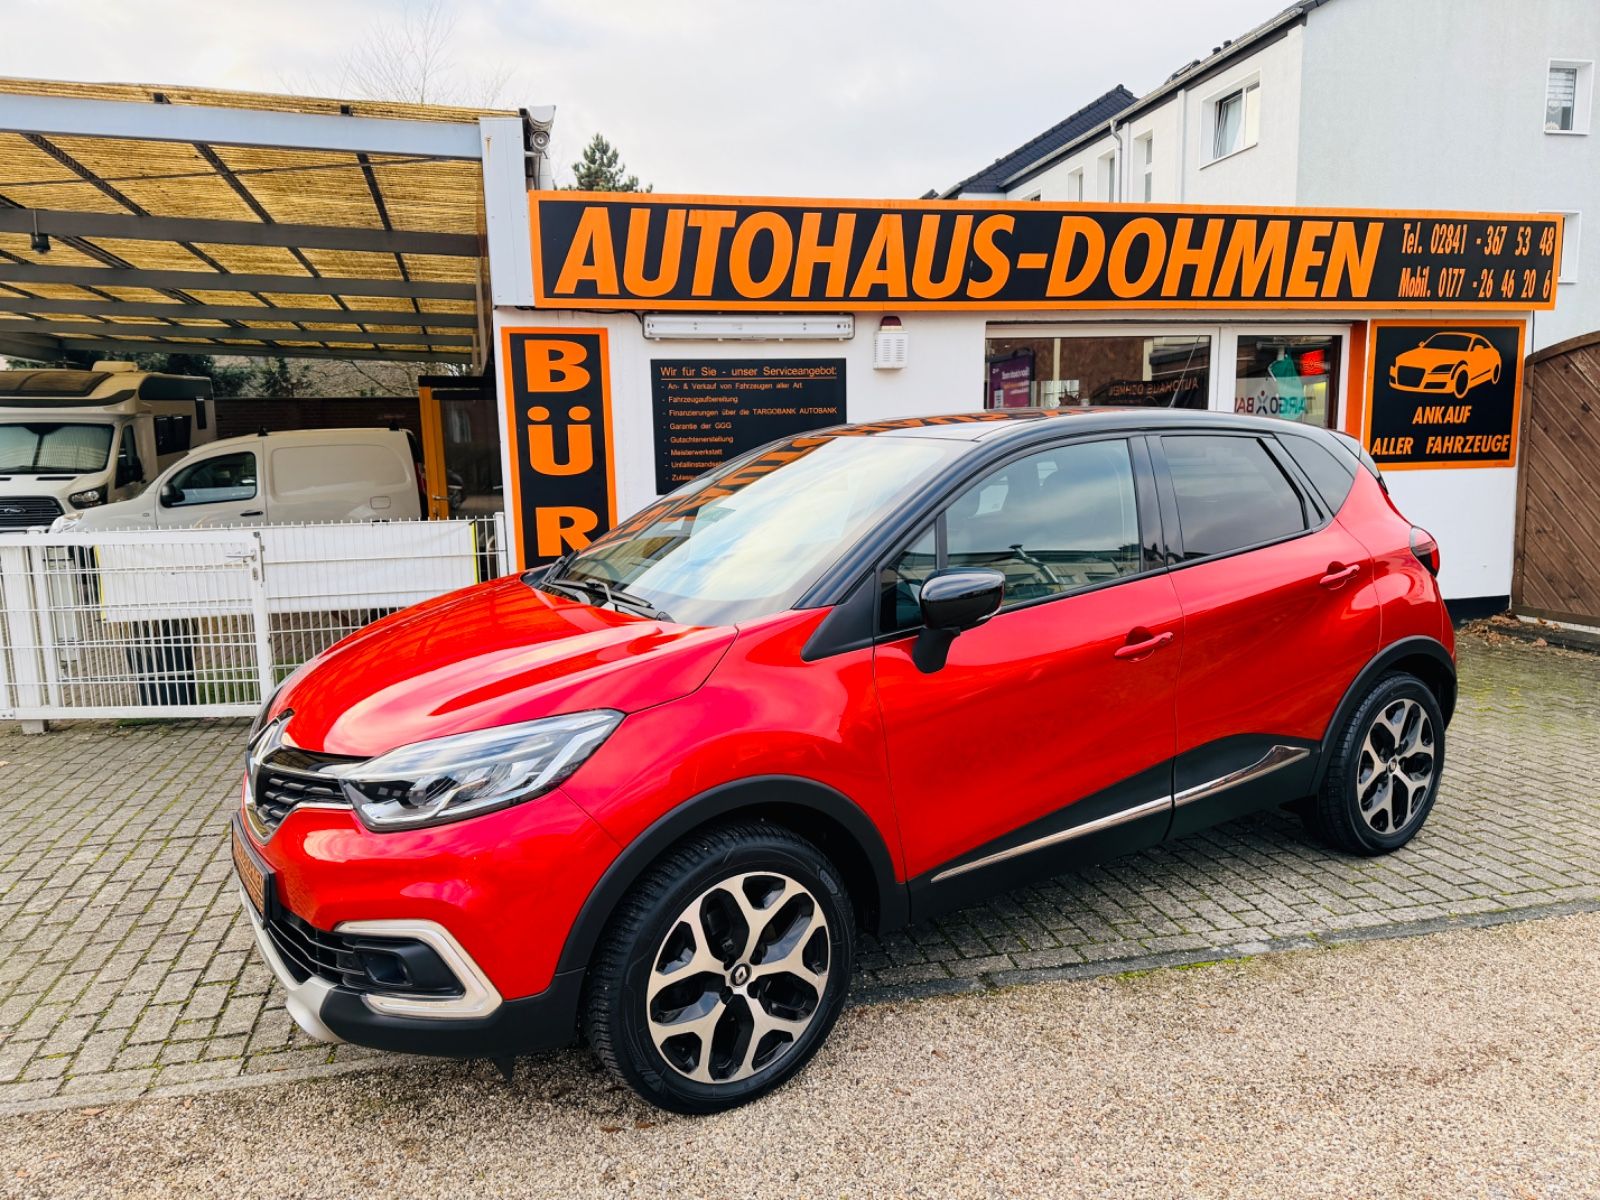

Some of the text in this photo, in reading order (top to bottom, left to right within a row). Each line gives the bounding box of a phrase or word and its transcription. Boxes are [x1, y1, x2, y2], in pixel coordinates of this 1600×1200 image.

[1401, 222, 1423, 254] Tel.
[1430, 223, 1468, 254] 02841
[1514, 226, 1532, 256] 53
[1539, 227, 1555, 256] 48
[554, 206, 1384, 299] AUTOHAUS-DOHMEN
[1398, 266, 1431, 298] Mobil.
[1437, 267, 1466, 298] 0177
[1501, 269, 1515, 299] 46
[1521, 269, 1537, 299] 20
[1542, 269, 1551, 299] 6
[660, 366, 677, 376] Wir
[682, 366, 695, 376] für
[701, 366, 717, 377] Sie
[731, 367, 757, 377] unser
[763, 366, 837, 378] Serviceangebot:
[691, 382, 717, 390] Verkauf
[735, 382, 773, 391] Fahrzeugen
[776, 382, 790, 390] aller
[668, 395, 738, 404] Fahrzeugaufbereitung
[669, 408, 718, 417] Finanzierungen
[752, 407, 797, 416] TARGOBANK
[800, 407, 837, 415] AUTOBANK
[1412, 405, 1472, 425] ANKAUF
[670, 422, 697, 431] Garantie
[1371, 434, 1510, 456] ALLER FAHRZEUGE
